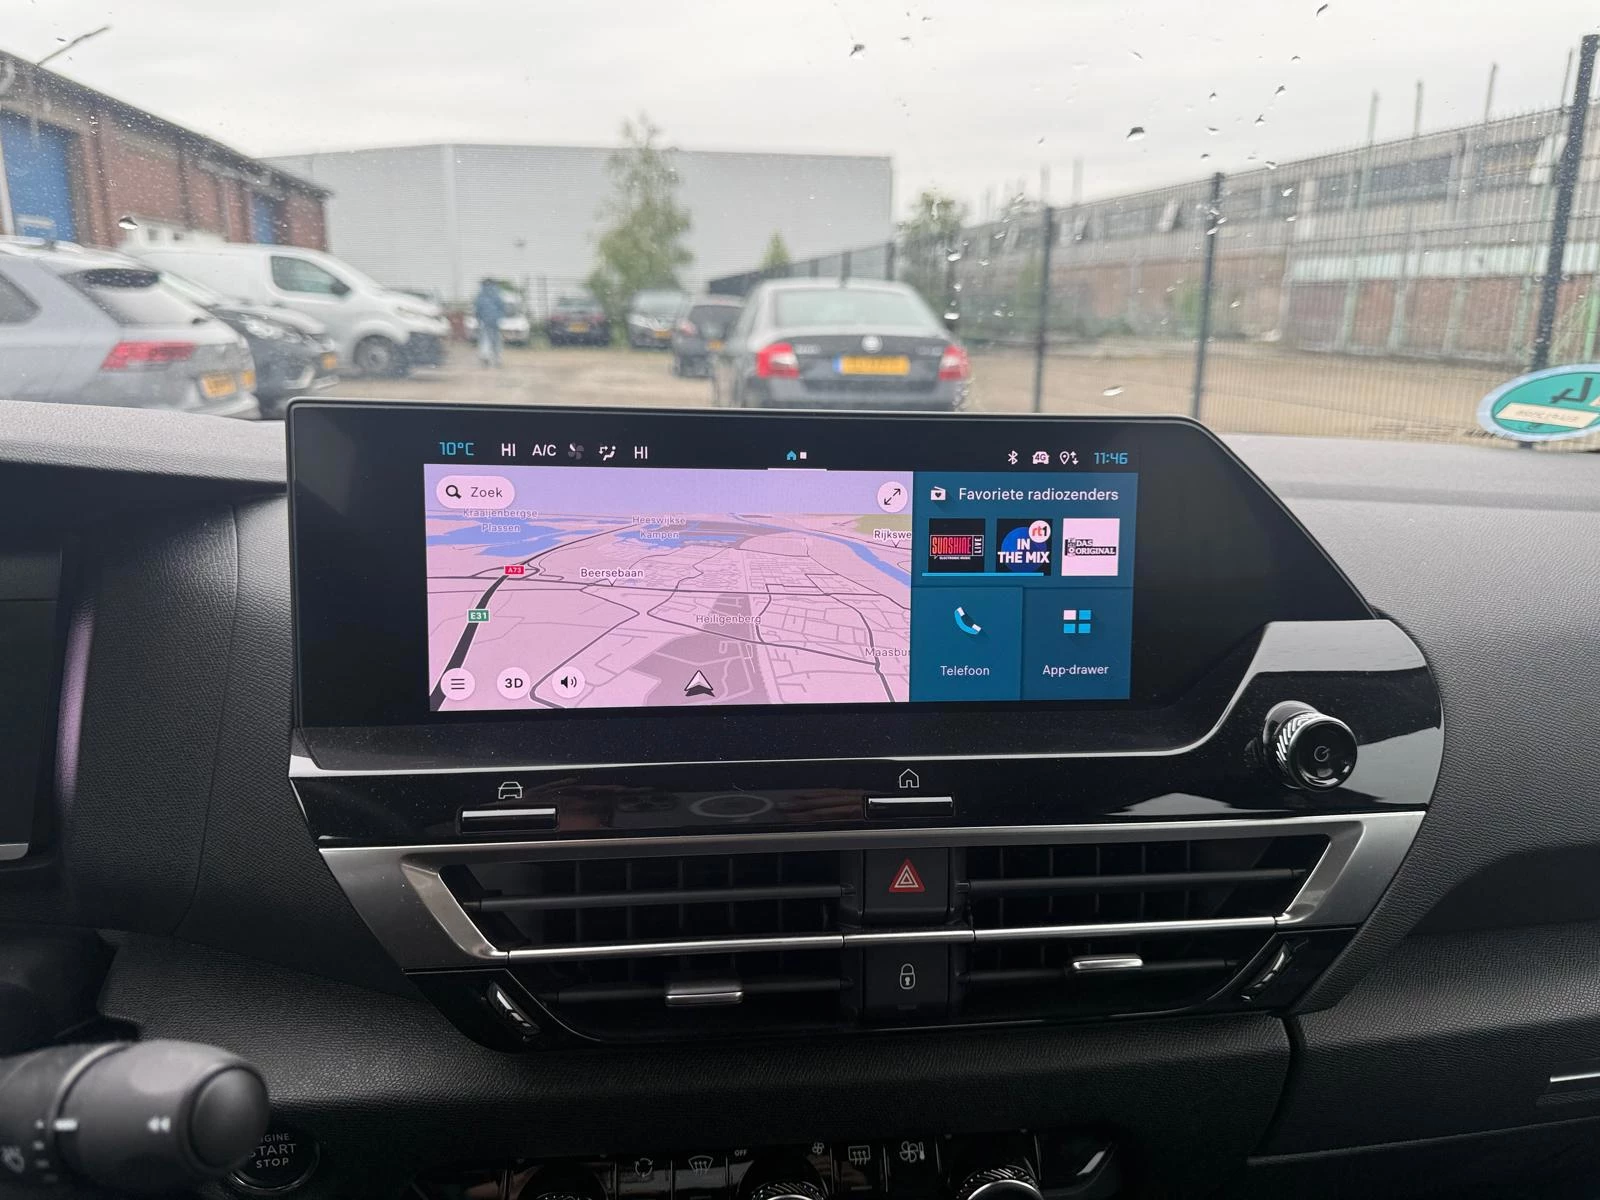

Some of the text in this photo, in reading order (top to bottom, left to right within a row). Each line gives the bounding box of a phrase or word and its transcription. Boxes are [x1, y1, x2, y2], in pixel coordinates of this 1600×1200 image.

[439, 442, 475, 456] 10°C
[501, 443, 516, 457] HI
[532, 444, 557, 457] A/C
[634, 446, 648, 459] HI
[1034, 453, 1047, 461] 4G
[1093, 452, 1128, 465] 11:46
[470, 486, 503, 499] Zoek
[958, 487, 1119, 501] Favoriete radiozenders
[463, 508, 538, 519] Kraaijenbergse
[632, 515, 686, 526] Heeswijkse
[482, 523, 520, 532] Plassen
[1031, 525, 1048, 537] rt1
[640, 530, 679, 541] Kampen
[874, 530, 912, 541] Rijkswe
[931, 536, 972, 555] SUNSHINE
[974, 537, 982, 554] LIVE
[1017, 538, 1031, 550] IN
[1076, 539, 1093, 547] DAS
[1075, 547, 1116, 555] ORIGINAL
[997, 551, 1050, 564] THE MIX
[580, 567, 644, 578] Beersebaan
[470, 612, 488, 620] E31
[696, 613, 761, 625] Heiligenberg
[940, 665, 990, 677] Telefoon
[1042, 664, 1109, 678] App-drawer
[504, 678, 523, 689] 3D
[261, 1133, 290, 1143] GINE
[256, 1157, 289, 1169] STOP
